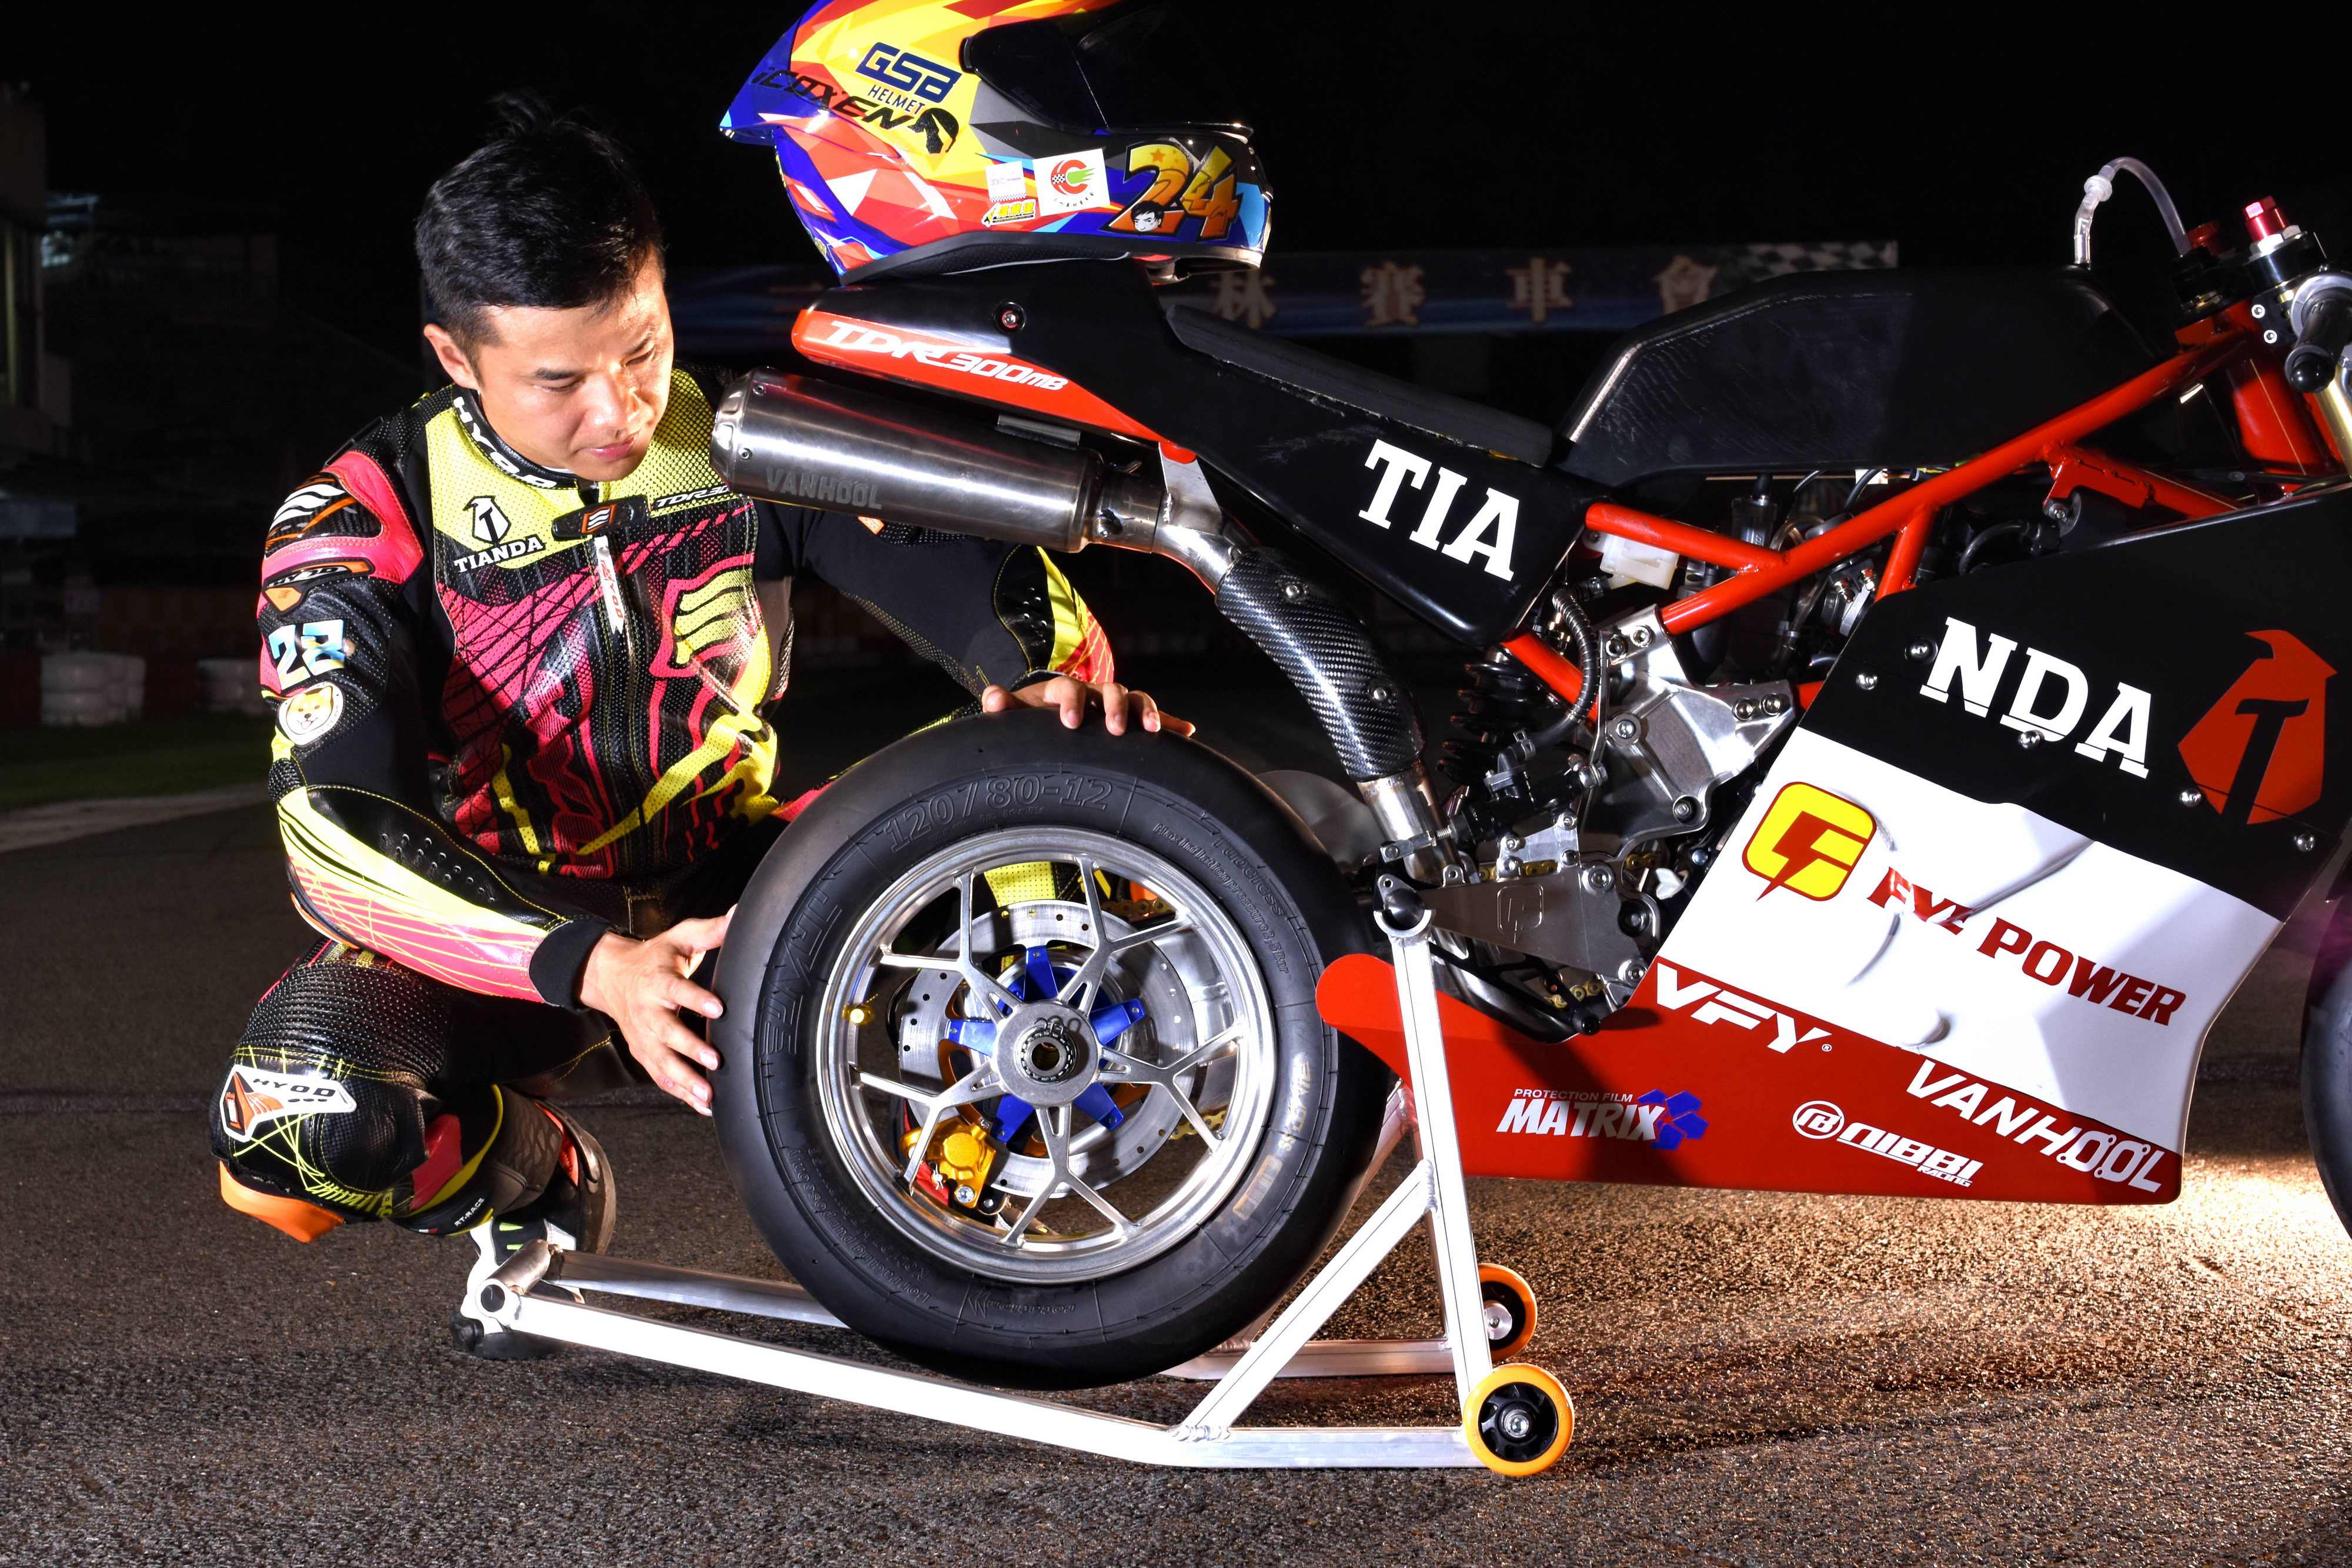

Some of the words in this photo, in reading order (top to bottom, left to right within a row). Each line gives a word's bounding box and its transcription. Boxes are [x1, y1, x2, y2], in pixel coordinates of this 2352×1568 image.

[867, 84, 926, 115] HELMET
[1109, 142, 1240, 238] 24
[453, 396, 557, 489] HYOD
[766, 469, 883, 510] VANHOOL
[1358, 439, 1519, 581] TIA
[455, 536, 543, 573] TIANDA
[1920, 616, 2151, 779] NDA
[883, 774, 1112, 852] 120/80-12
[1212, 835, 1285, 917] Tubeless
[1976, 917, 2187, 1026] POWER
[252, 1077, 336, 1098] HYOD
[1514, 1089, 1600, 1101] PROTECTION
[1602, 1093, 1633, 1103] FILM
[1496, 1098, 1666, 1141] MATRIX
[1906, 1059, 2166, 1193] VANHOOL
[1917, 1165, 1973, 1188] RACING
[455, 1198, 485, 1226] RT-RACE
